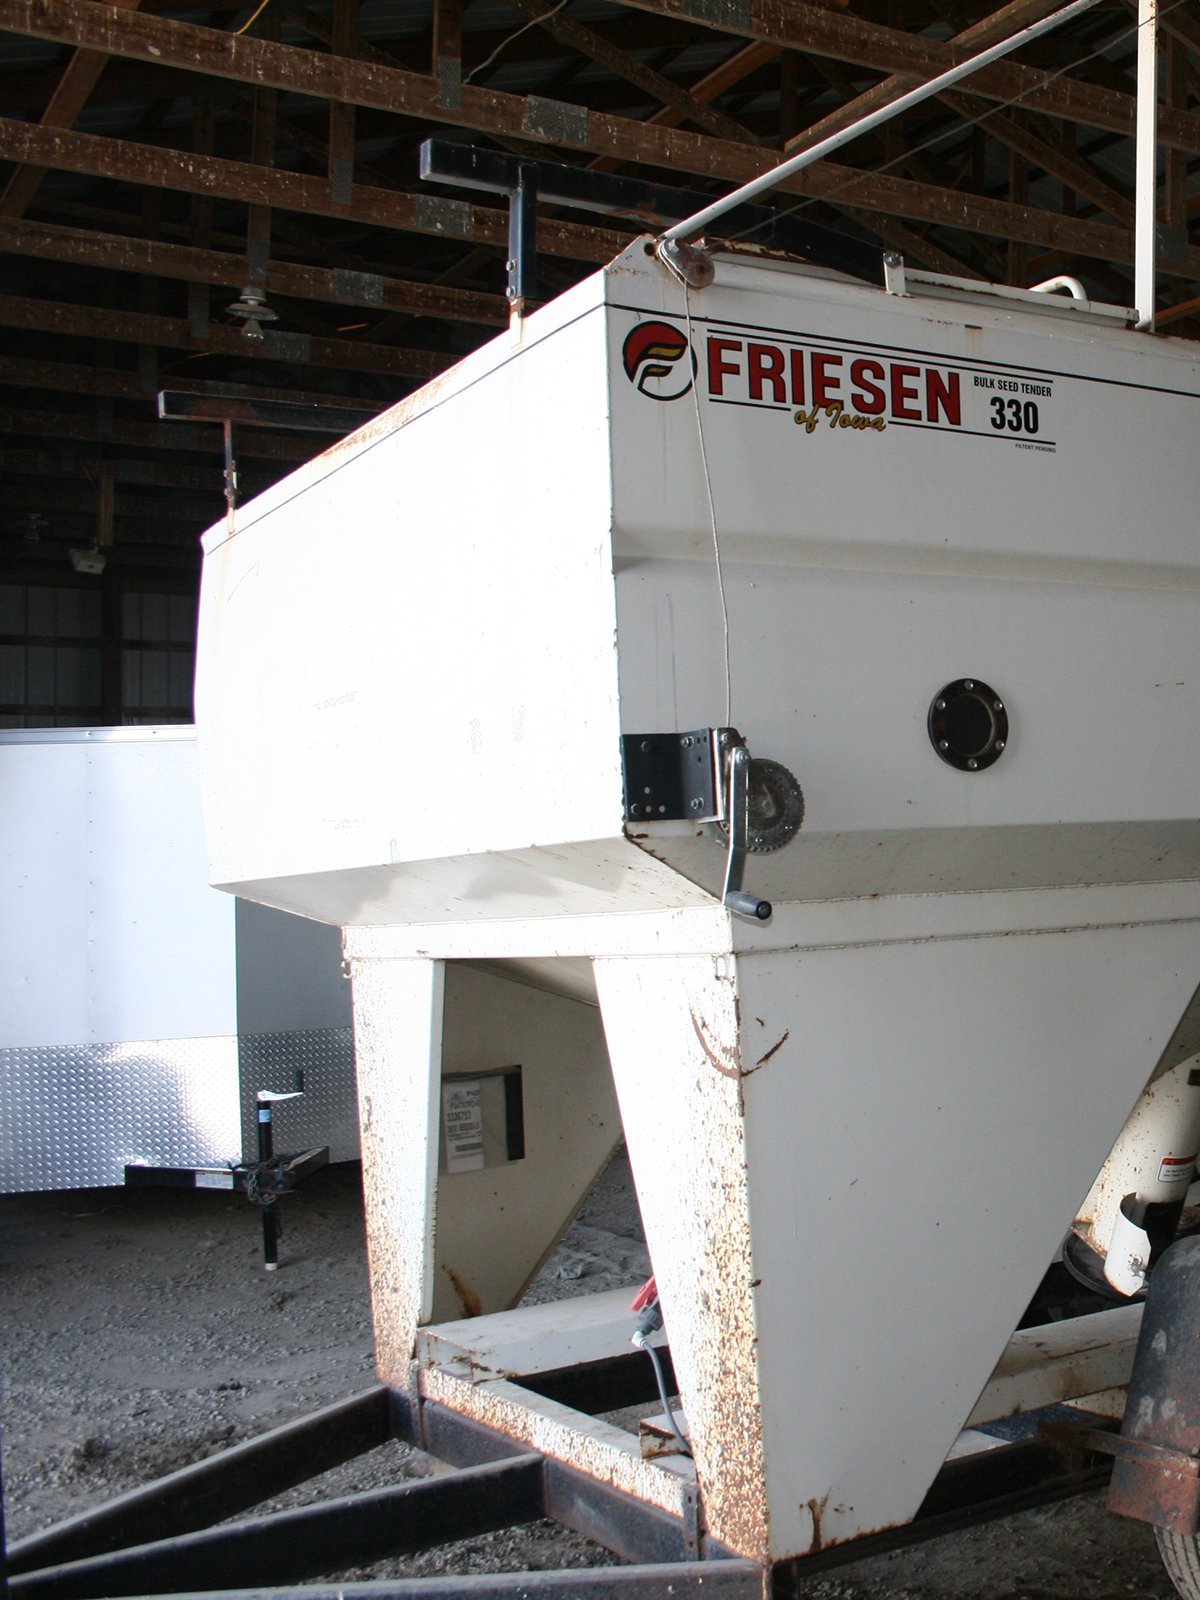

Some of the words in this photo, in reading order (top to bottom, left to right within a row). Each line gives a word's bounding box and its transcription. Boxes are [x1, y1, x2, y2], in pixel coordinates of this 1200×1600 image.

[707, 336, 962, 426] FRIESEN
[973, 376, 996, 389] BULK
[997, 379, 1019, 392] SEED
[1020, 383, 1052, 397] TENDER
[793, 403, 820, 434] of
[824, 402, 887, 432] Iowa
[990, 396, 1039, 434] 330
[1014, 443, 1034, 451] PATENT
[1034, 445, 1057, 453] PENDING
